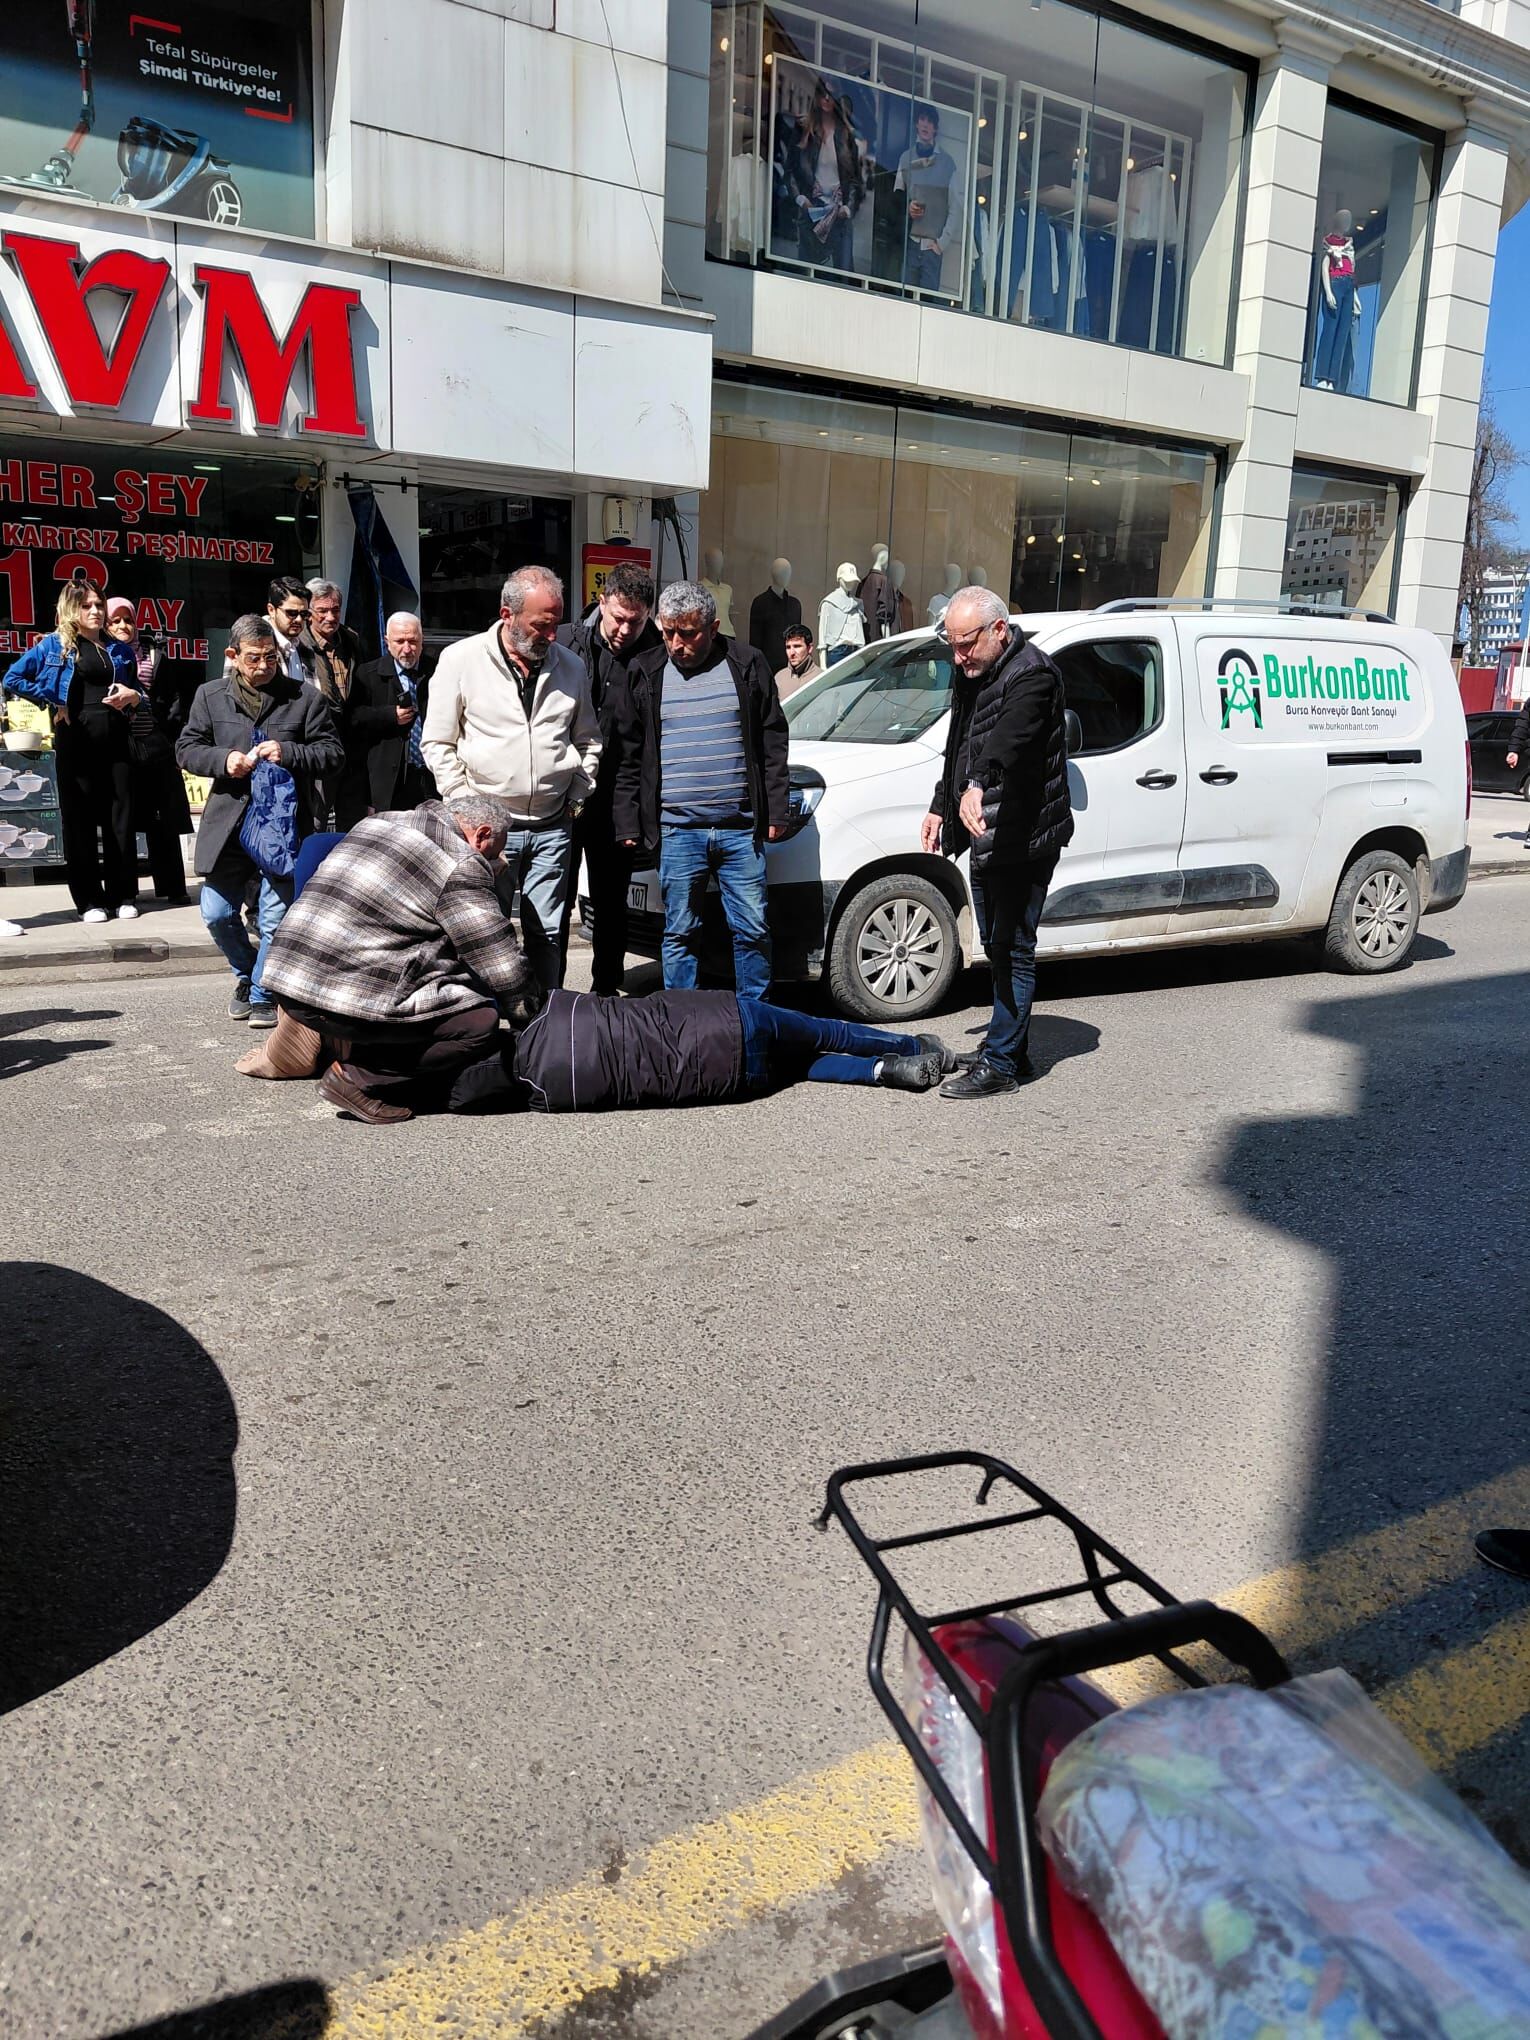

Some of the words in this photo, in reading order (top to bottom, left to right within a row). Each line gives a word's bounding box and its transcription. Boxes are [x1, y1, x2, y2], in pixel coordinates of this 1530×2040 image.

[139, 59, 188, 82] Şimdi
[146, 38, 186, 60] Tefal
[191, 49, 278, 82] Süpürgeler
[0, 230, 368, 441] VM
[0, 458, 97, 509] HER
[114, 469, 208, 523] ŞEY
[2, 522, 119, 554] KARTSIZ
[127, 530, 275, 566] PEŞİNATSIZ
[136, 597, 185, 632] AY
[1263, 654, 1410, 702] BurkonBant
[1286, 705, 1309, 716] Bursa
[1311, 705, 1349, 718] Konveyör
[1351, 705, 1370, 717] Bant
[1371, 706, 1397, 718] Sanayi
[1308, 722, 1379, 732] www.burkonbant.com
